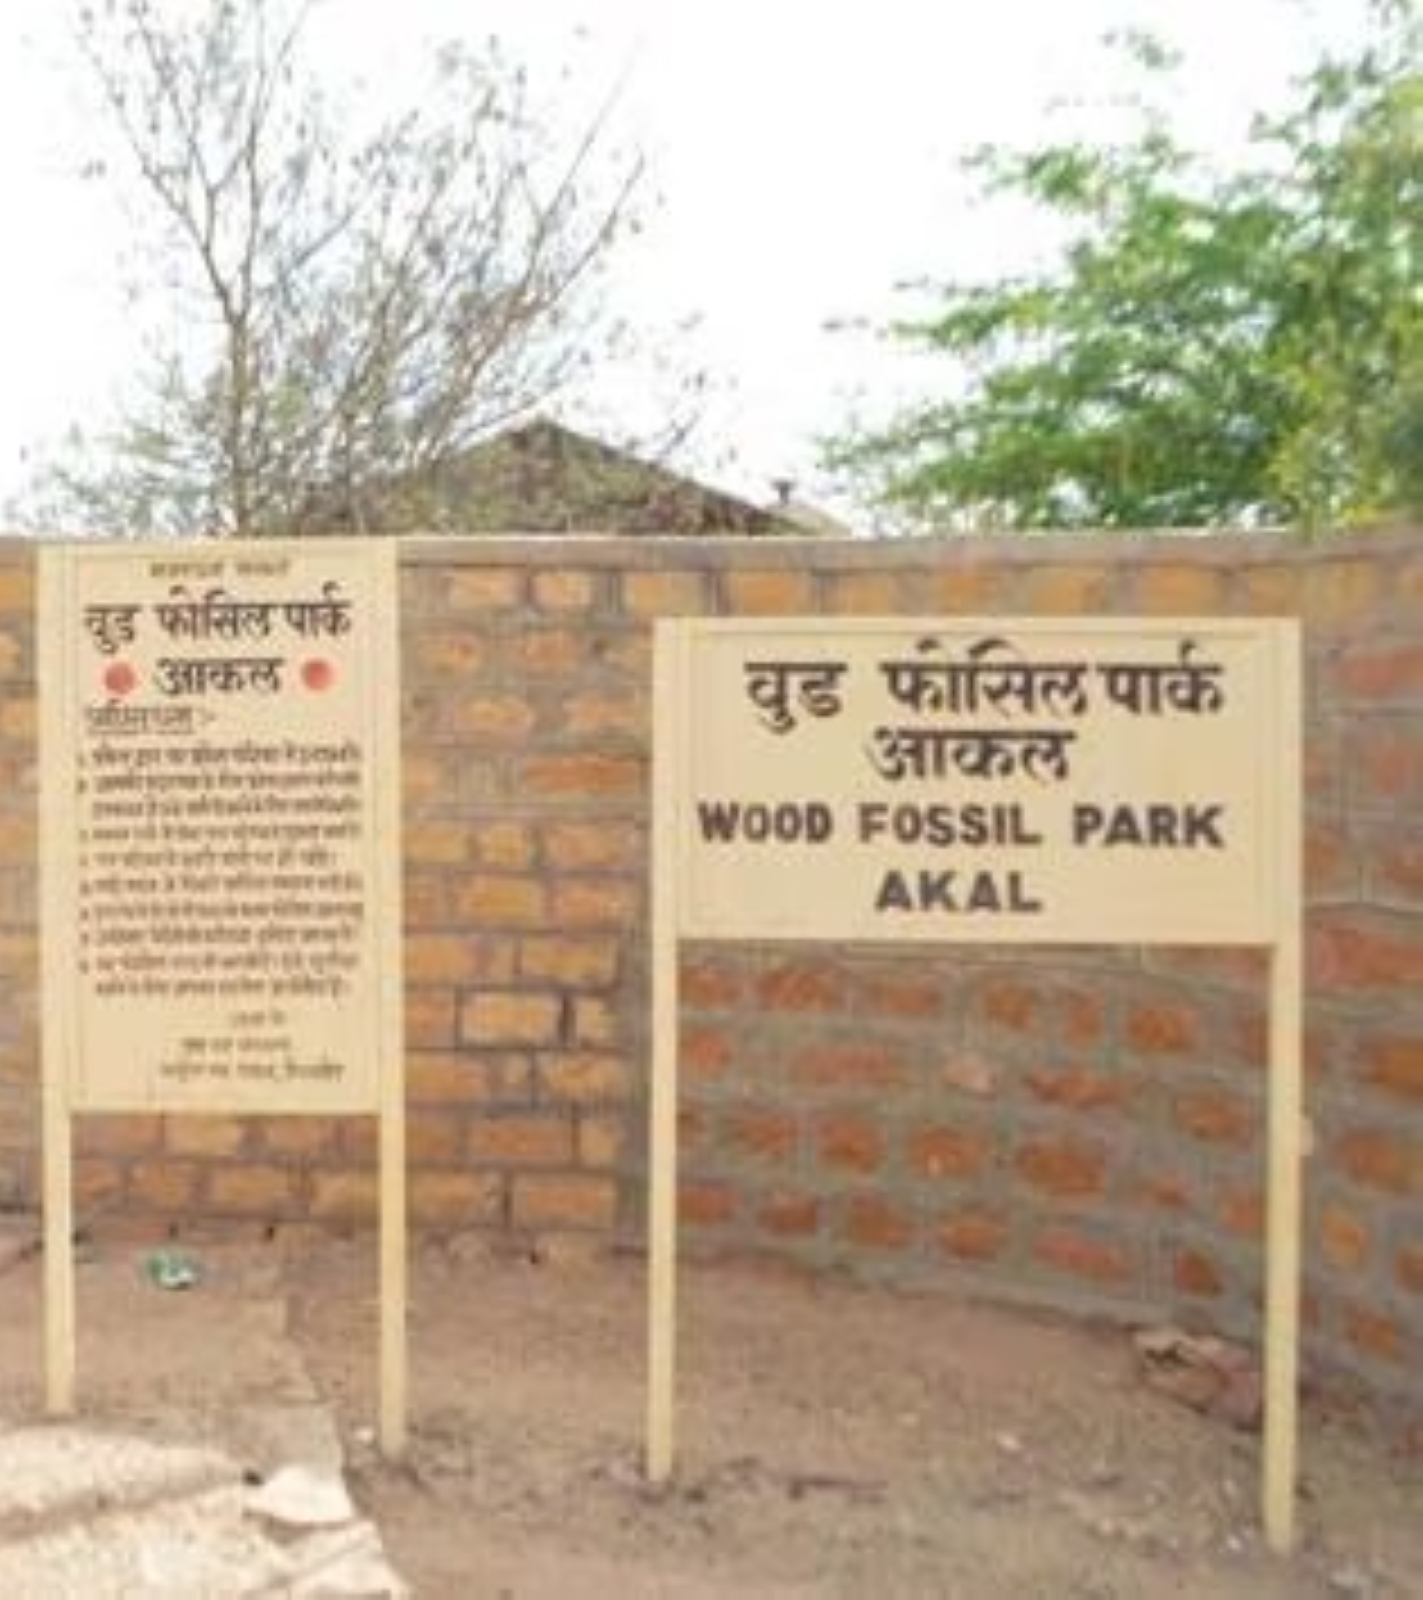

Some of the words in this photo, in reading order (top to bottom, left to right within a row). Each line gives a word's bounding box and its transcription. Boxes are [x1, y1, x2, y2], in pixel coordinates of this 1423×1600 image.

[84, 604, 140, 655] वुड
[278, 581, 352, 639] पार्क
[156, 657, 285, 697] आकल
[744, 662, 848, 732] वुड
[880, 637, 1089, 717] फोसिल
[1096, 640, 1224, 716] पार्क
[872, 727, 1076, 783] आकल
[697, 802, 834, 845] WOOD
[859, 803, 1043, 847] FOSSIL
[1073, 804, 1225, 846] PARK
[875, 870, 1043, 914] AKAL
